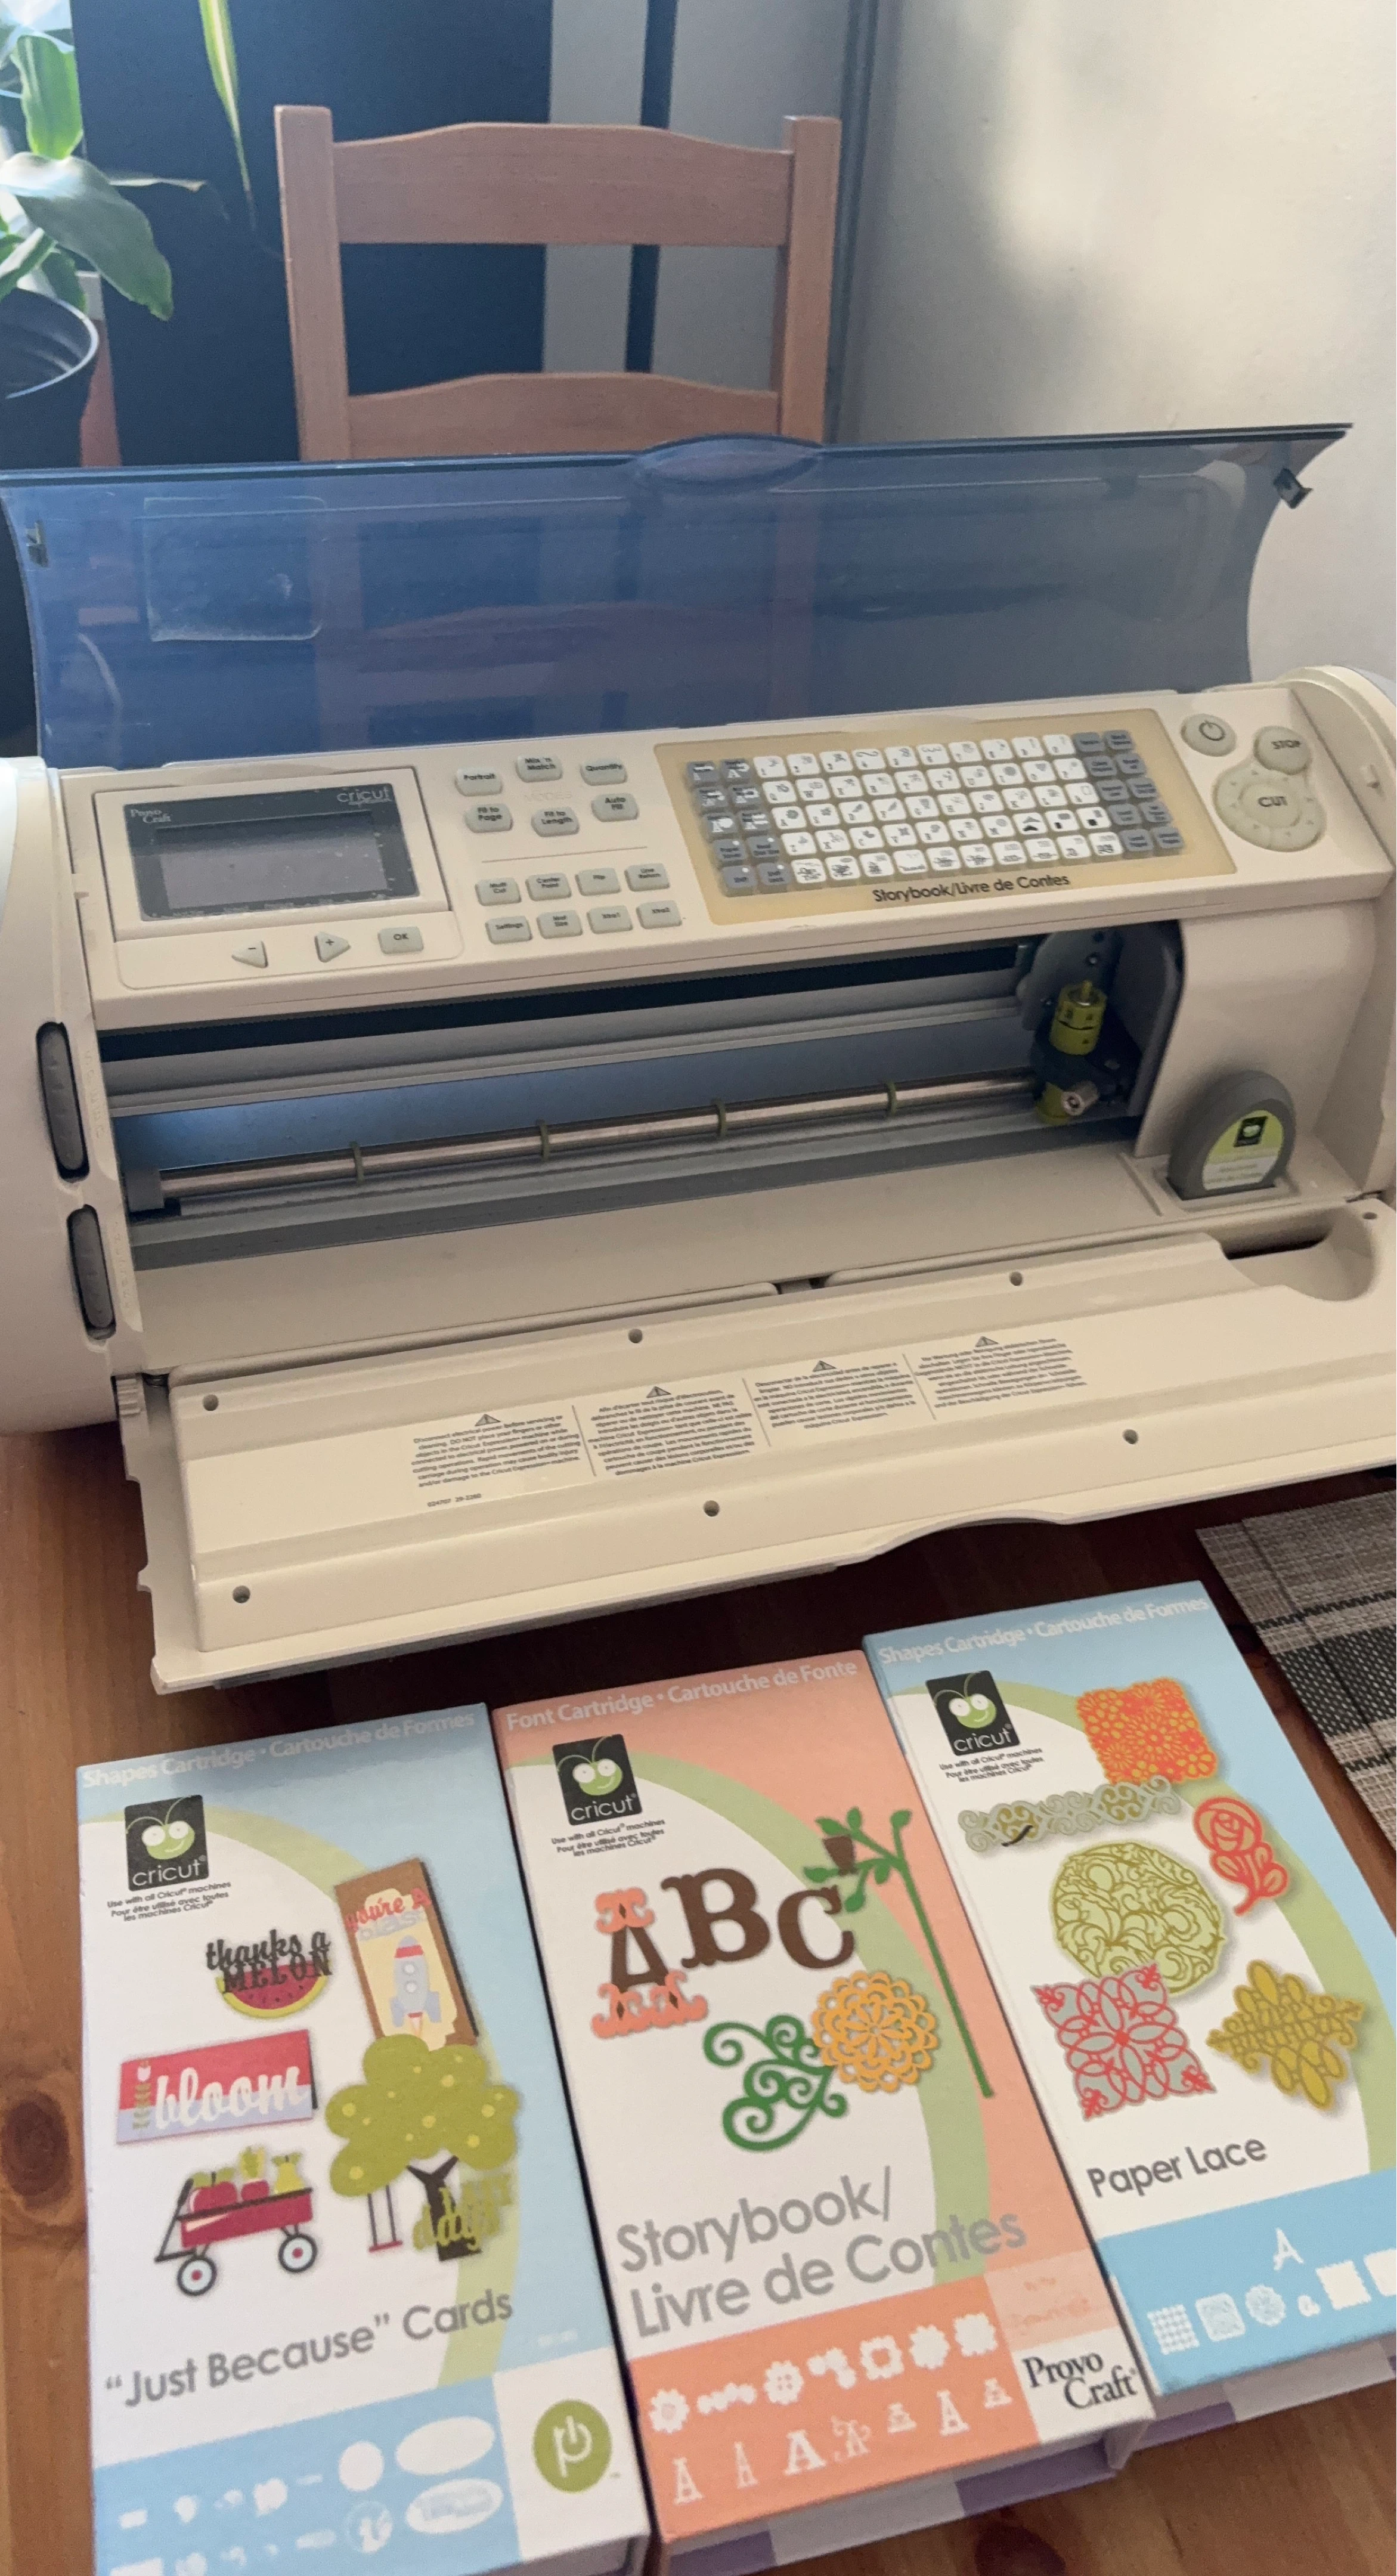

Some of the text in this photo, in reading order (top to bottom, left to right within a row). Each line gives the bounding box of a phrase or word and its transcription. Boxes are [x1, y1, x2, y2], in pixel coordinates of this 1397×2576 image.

[1271, 740, 1301, 750] STOP
[337, 787, 390, 803] cricut
[1258, 796, 1287, 807] CUT
[130, 809, 162, 818] Provo
[143, 814, 171, 823] Craft
[994, 879, 1014, 891] de
[1016, 875, 1070, 889] Contes
[878, 1596, 1209, 1665] Shapes Cartridge Cartouche de Formes
[507, 1659, 857, 1730] Font Cartridge Cartouche de Fonte
[83, 1713, 475, 1787] Shapes Cartridge Cartouche de Formes
[954, 1727, 1011, 1751] cricut
[1006, 1748, 1043, 1758] machines
[571, 1795, 633, 1820] cricut
[568, 1833, 584, 1841] with
[626, 1819, 665, 1831] machines
[618, 1833, 637, 1841] avec
[640, 1829, 664, 1838] toutes
[587, 1842, 625, 1854] machines
[132, 1859, 200, 1886] cricut
[178, 1897, 200, 1905] avec
[203, 1891, 229, 1901] toutes
[188, 1882, 231, 1894] machines
[138, 1906, 181, 1919] machines
[206, 1929, 331, 1970] thanks a
[221, 1950, 333, 1994] MELON
[155, 2066, 305, 2131] bloom
[1087, 2138, 1269, 2197] Paper Lace
[617, 2166, 891, 2272] Storybook/
[630, 2213, 1028, 2338] Livre de Contes
[402, 2290, 514, 2341] Cards
[1022, 2352, 1104, 2388] Provo
[1063, 2365, 1138, 2410] Craft
